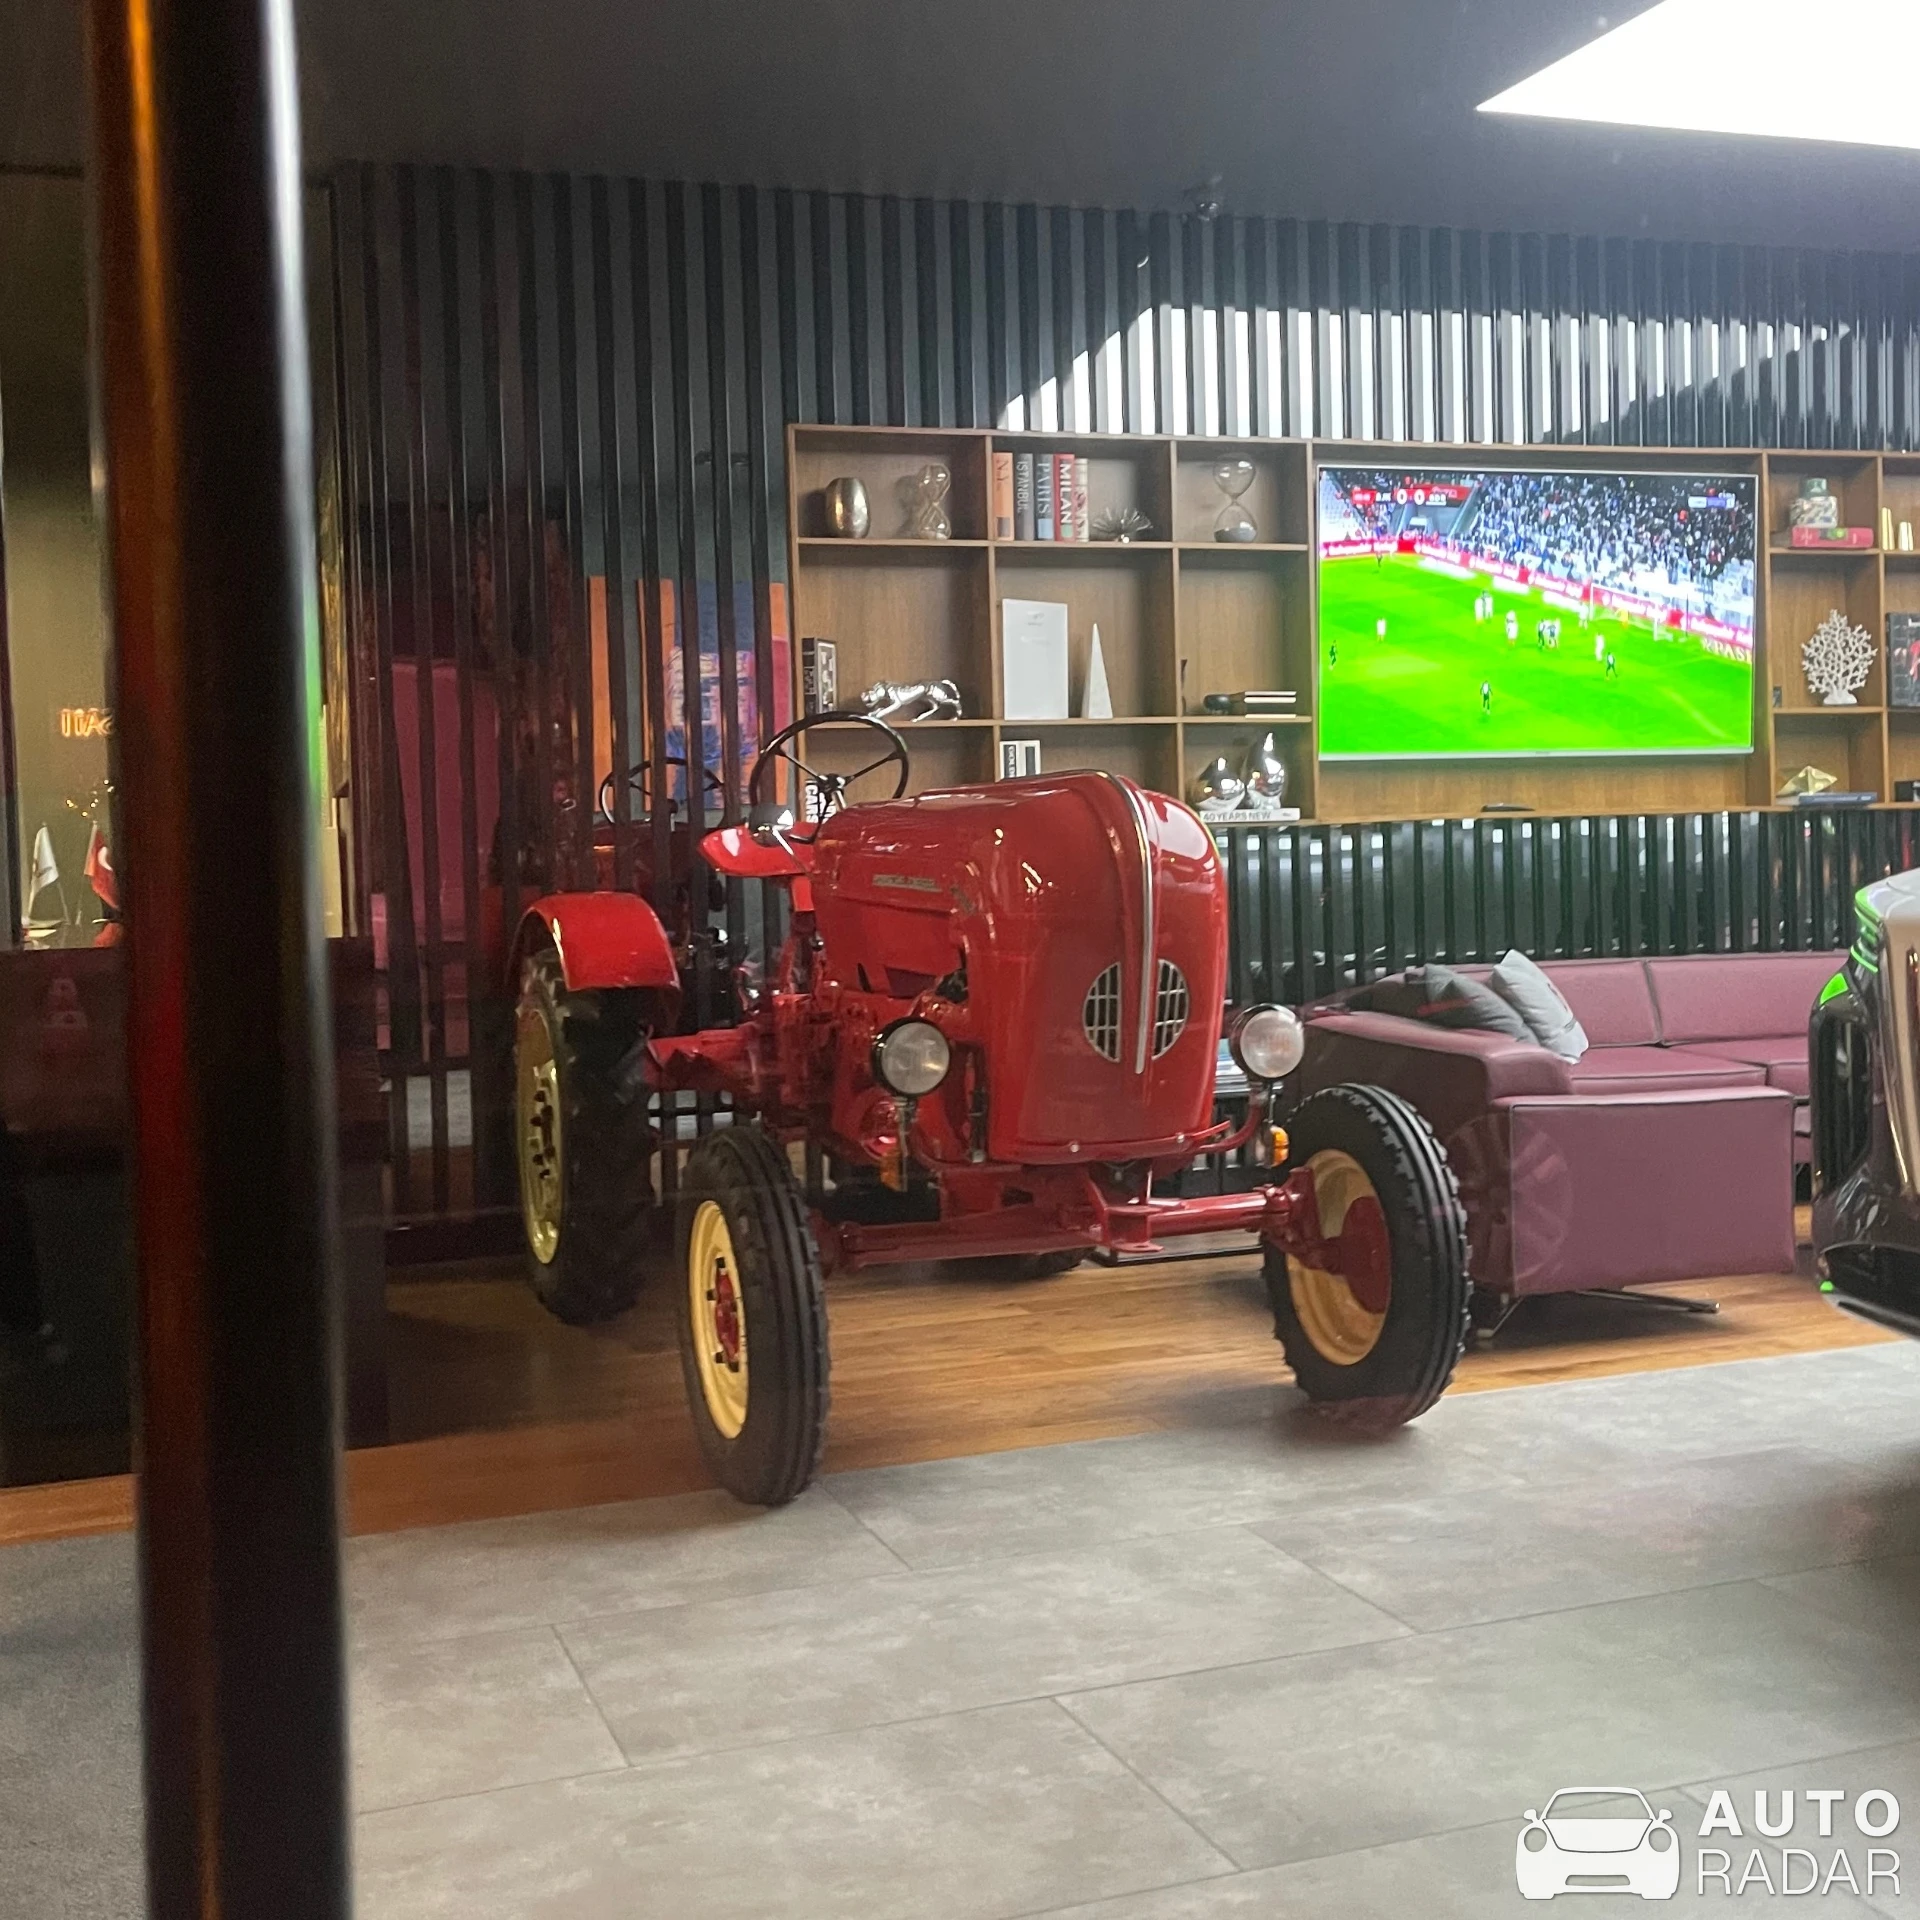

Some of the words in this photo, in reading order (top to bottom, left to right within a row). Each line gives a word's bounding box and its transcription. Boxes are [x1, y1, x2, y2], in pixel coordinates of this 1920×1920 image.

[1016, 461, 1029, 514] ISTANBUL
[1037, 462, 1051, 514] PARIS
[1060, 463, 1072, 524] MILAN
[805, 784, 819, 823] CARS
